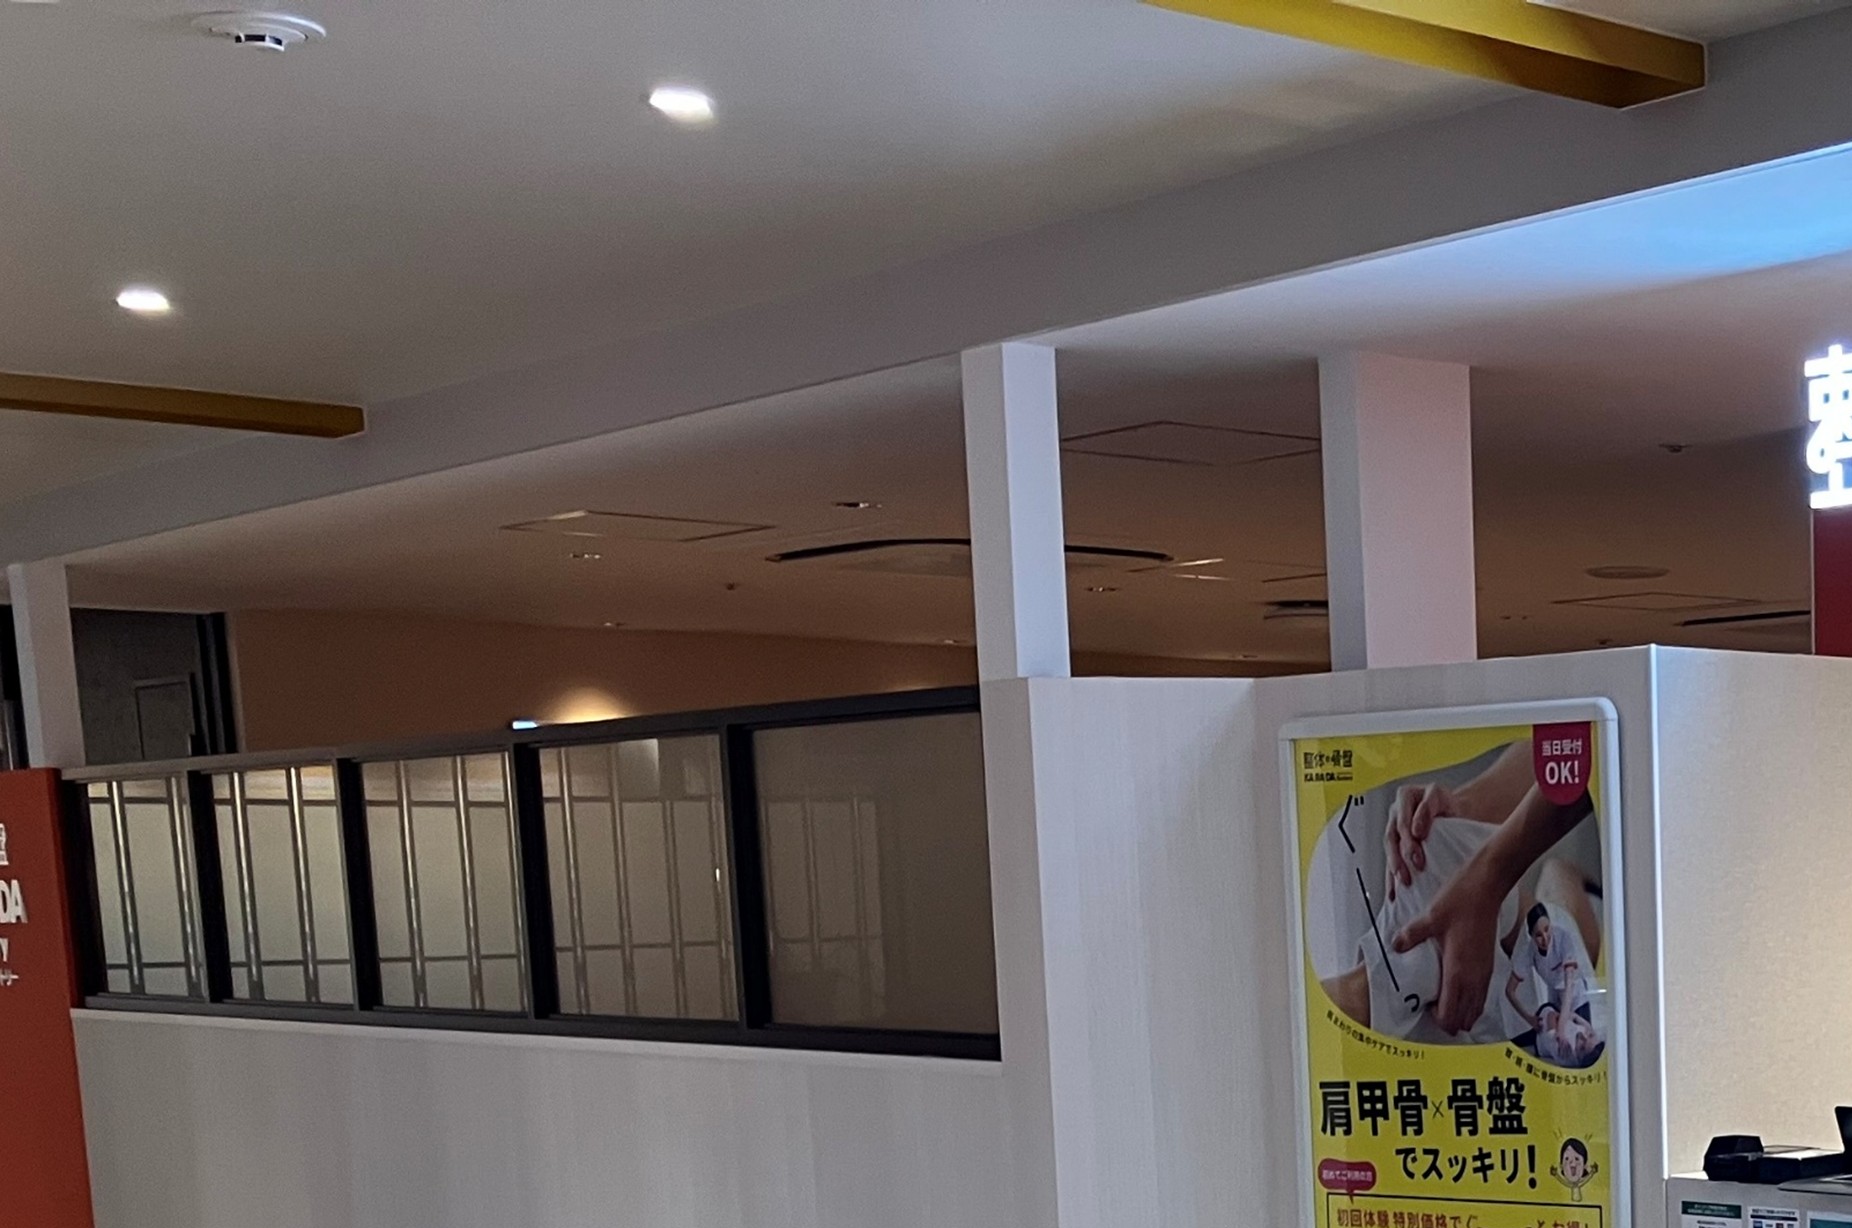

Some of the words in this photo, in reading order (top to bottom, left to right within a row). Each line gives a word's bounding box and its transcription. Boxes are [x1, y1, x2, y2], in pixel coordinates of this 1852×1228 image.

[1545, 760, 1580, 785] OK!
[1395, 1145, 1537, 1189] でスッキリ!
